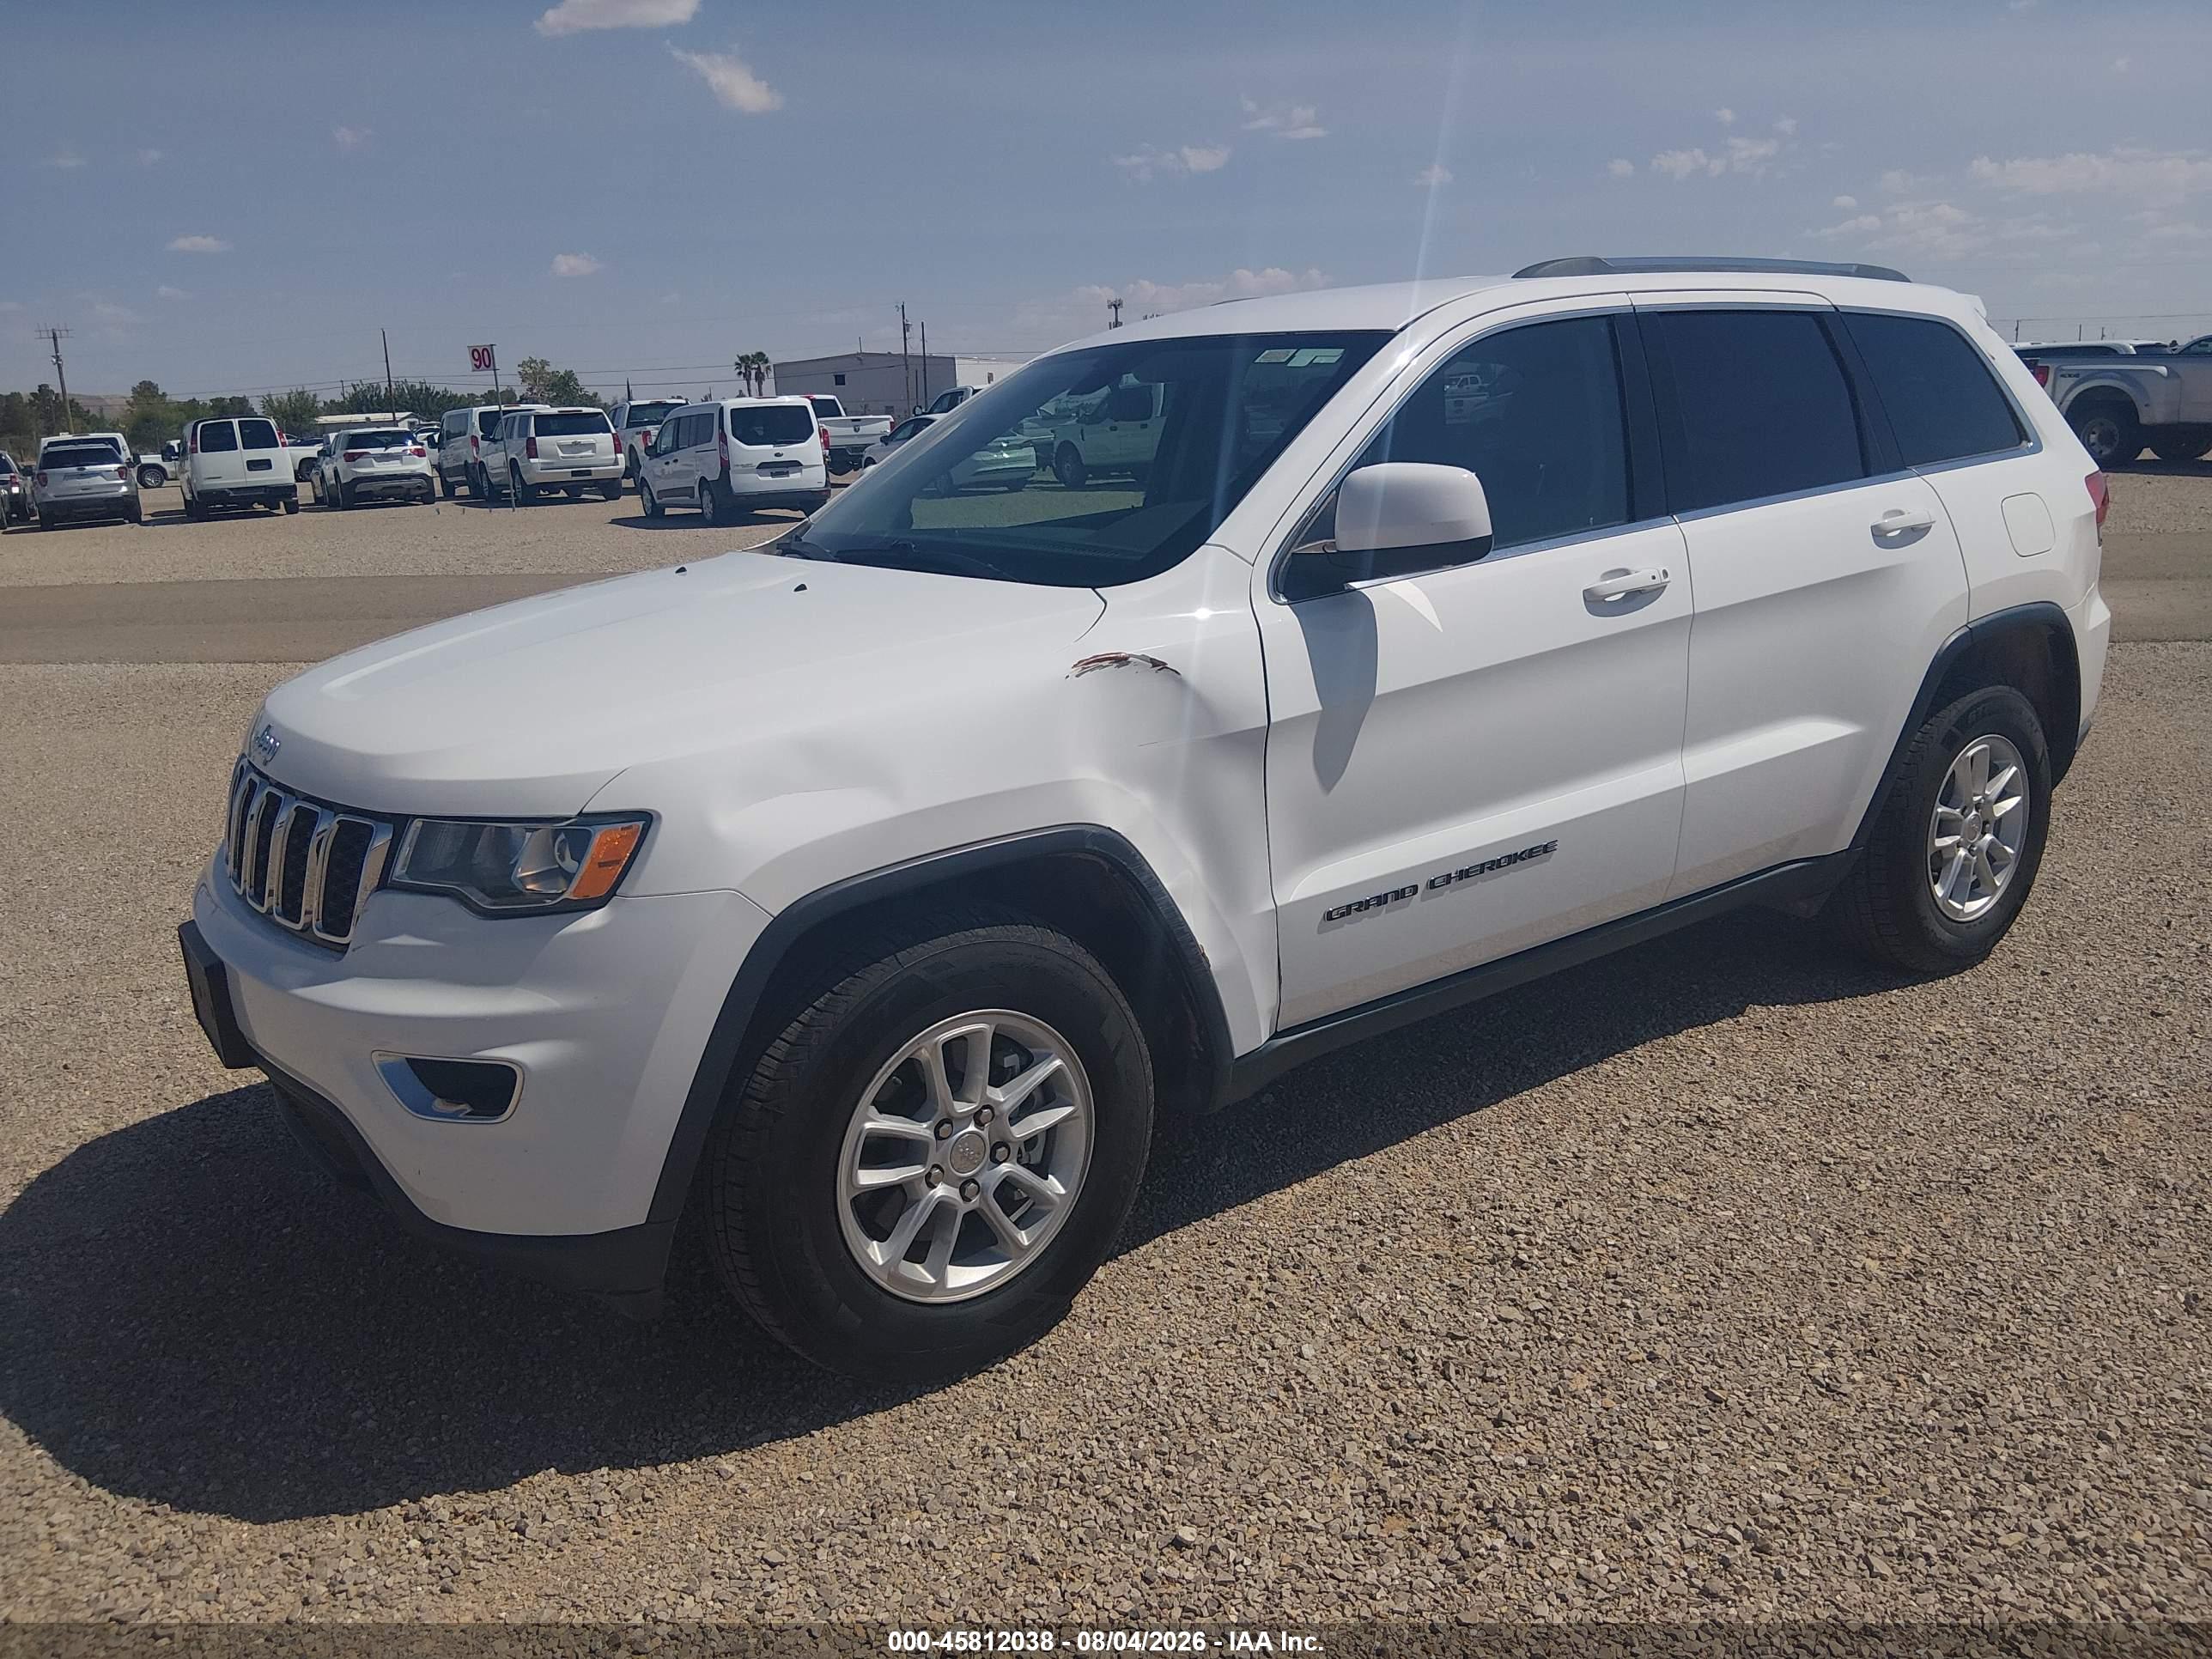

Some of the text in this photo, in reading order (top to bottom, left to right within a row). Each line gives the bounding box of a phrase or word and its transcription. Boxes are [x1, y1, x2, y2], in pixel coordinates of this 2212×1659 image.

[471, 347, 491, 369] 90
[1324, 839, 1559, 921] GRAND CHEROKEE
